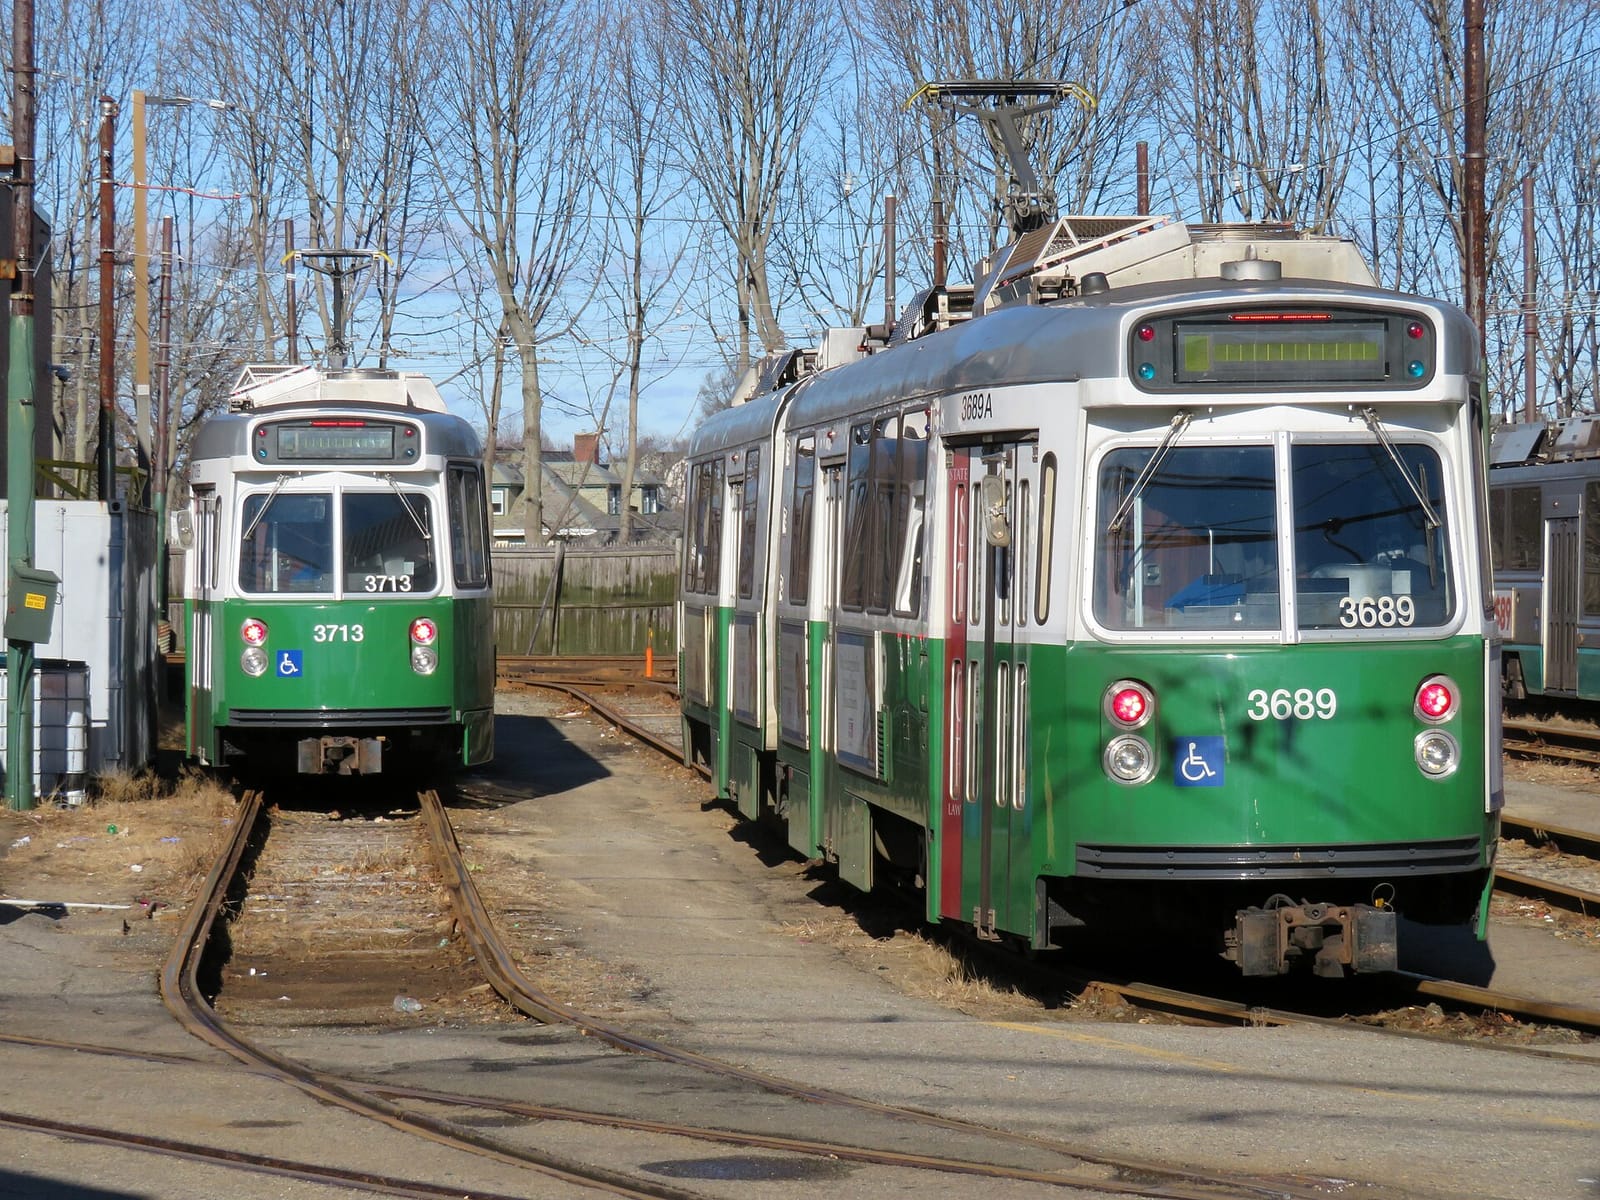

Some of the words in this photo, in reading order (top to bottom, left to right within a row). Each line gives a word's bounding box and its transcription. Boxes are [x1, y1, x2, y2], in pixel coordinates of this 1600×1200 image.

[961, 393, 993, 421] 3689A
[949, 467, 968, 481] STATE
[364, 574, 412, 592] 3713
[1339, 596, 1416, 628] 3689
[313, 624, 364, 642] 3713
[1247, 688, 1337, 721] 3689
[948, 803, 962, 816] LAW
